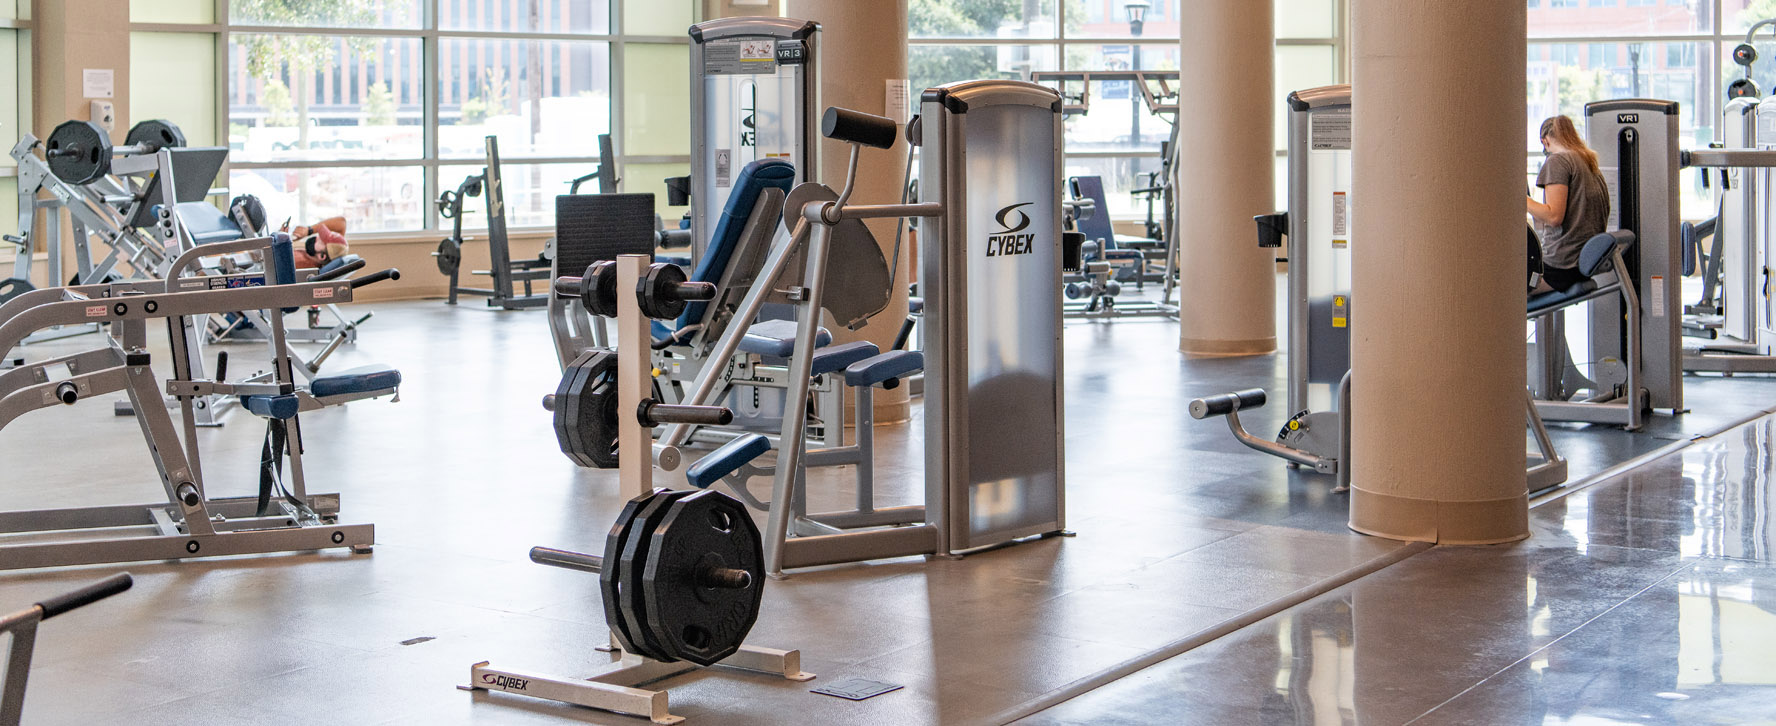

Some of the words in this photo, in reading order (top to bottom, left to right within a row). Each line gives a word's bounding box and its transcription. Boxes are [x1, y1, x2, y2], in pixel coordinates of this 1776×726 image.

[777, 50, 791, 58] VR
[1619, 114, 1638, 122] VR1
[986, 233, 1035, 257] CYBEX
[496, 674, 529, 690] CYBEX
